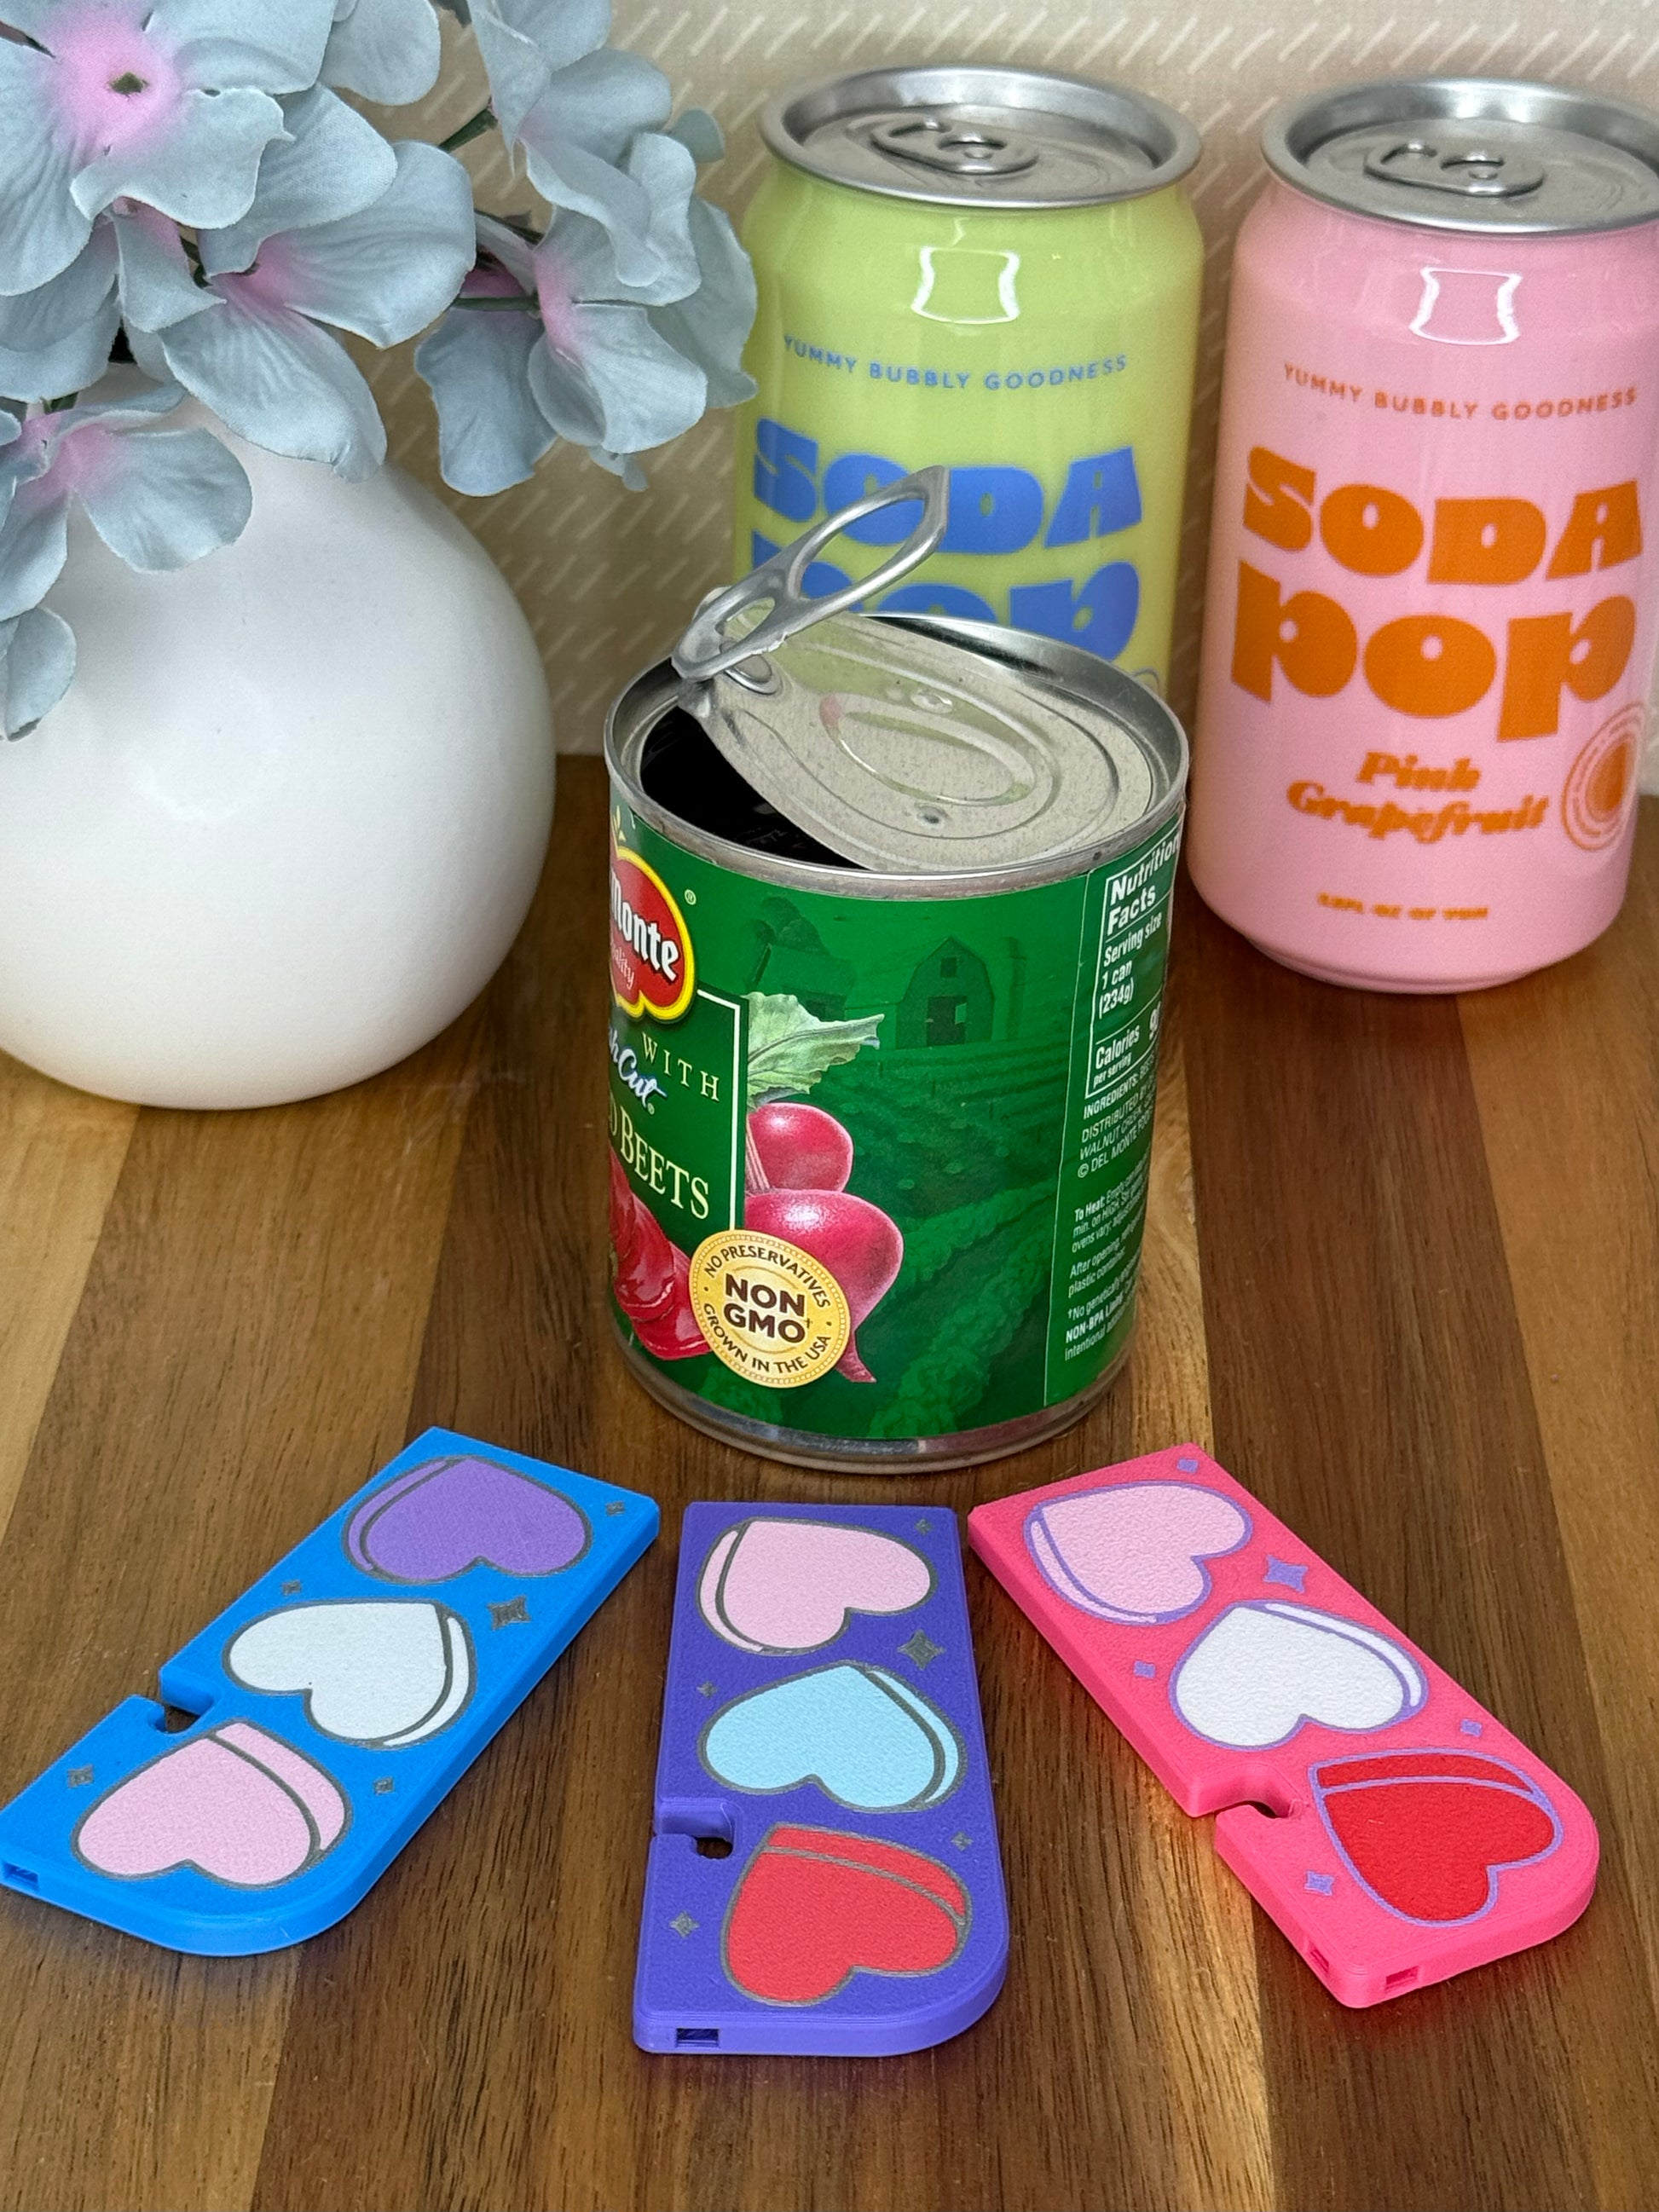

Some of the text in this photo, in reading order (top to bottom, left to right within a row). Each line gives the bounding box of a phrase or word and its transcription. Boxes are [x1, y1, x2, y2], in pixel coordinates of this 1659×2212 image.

[784, 335, 1127, 390] YUMMY BUBBLY GOODNESS
[1285, 362, 1637, 420] YUMMY BUBBLY GOODNESS
[754, 417, 1142, 554] SODA
[1242, 445, 1643, 585] SODA
[1110, 831, 1180, 906] Nutrition
[1107, 885, 1156, 936] Facts
[1103, 911, 1163, 967] Serving size
[1098, 977, 1135, 1019] (234g)
[1101, 960, 1133, 990] 1 can
[641, 1031, 720, 1101] WITH
[1095, 1025, 1140, 1070] Calories
[1079, 1123, 1121, 1161] WALNUT
[1081, 1092, 1139, 1144] DISTRIBUTED
[620, 1106, 708, 1220] BEETS
[1090, 1152, 1109, 1173] DEL
[1111, 1124, 1138, 1160] MONTE
[1074, 1207, 1084, 1222] To
[1069, 1256, 1091, 1279] After
[1072, 1232, 1095, 1253] ovens
[704, 1245, 831, 1308] NO PRESERVATIVES
[725, 1273, 806, 1318] NON
[1067, 1272, 1096, 1299] plastic
[703, 1302, 832, 1374] GROWN IN THE USA
[1066, 1308, 1105, 1344] NON-BPA
